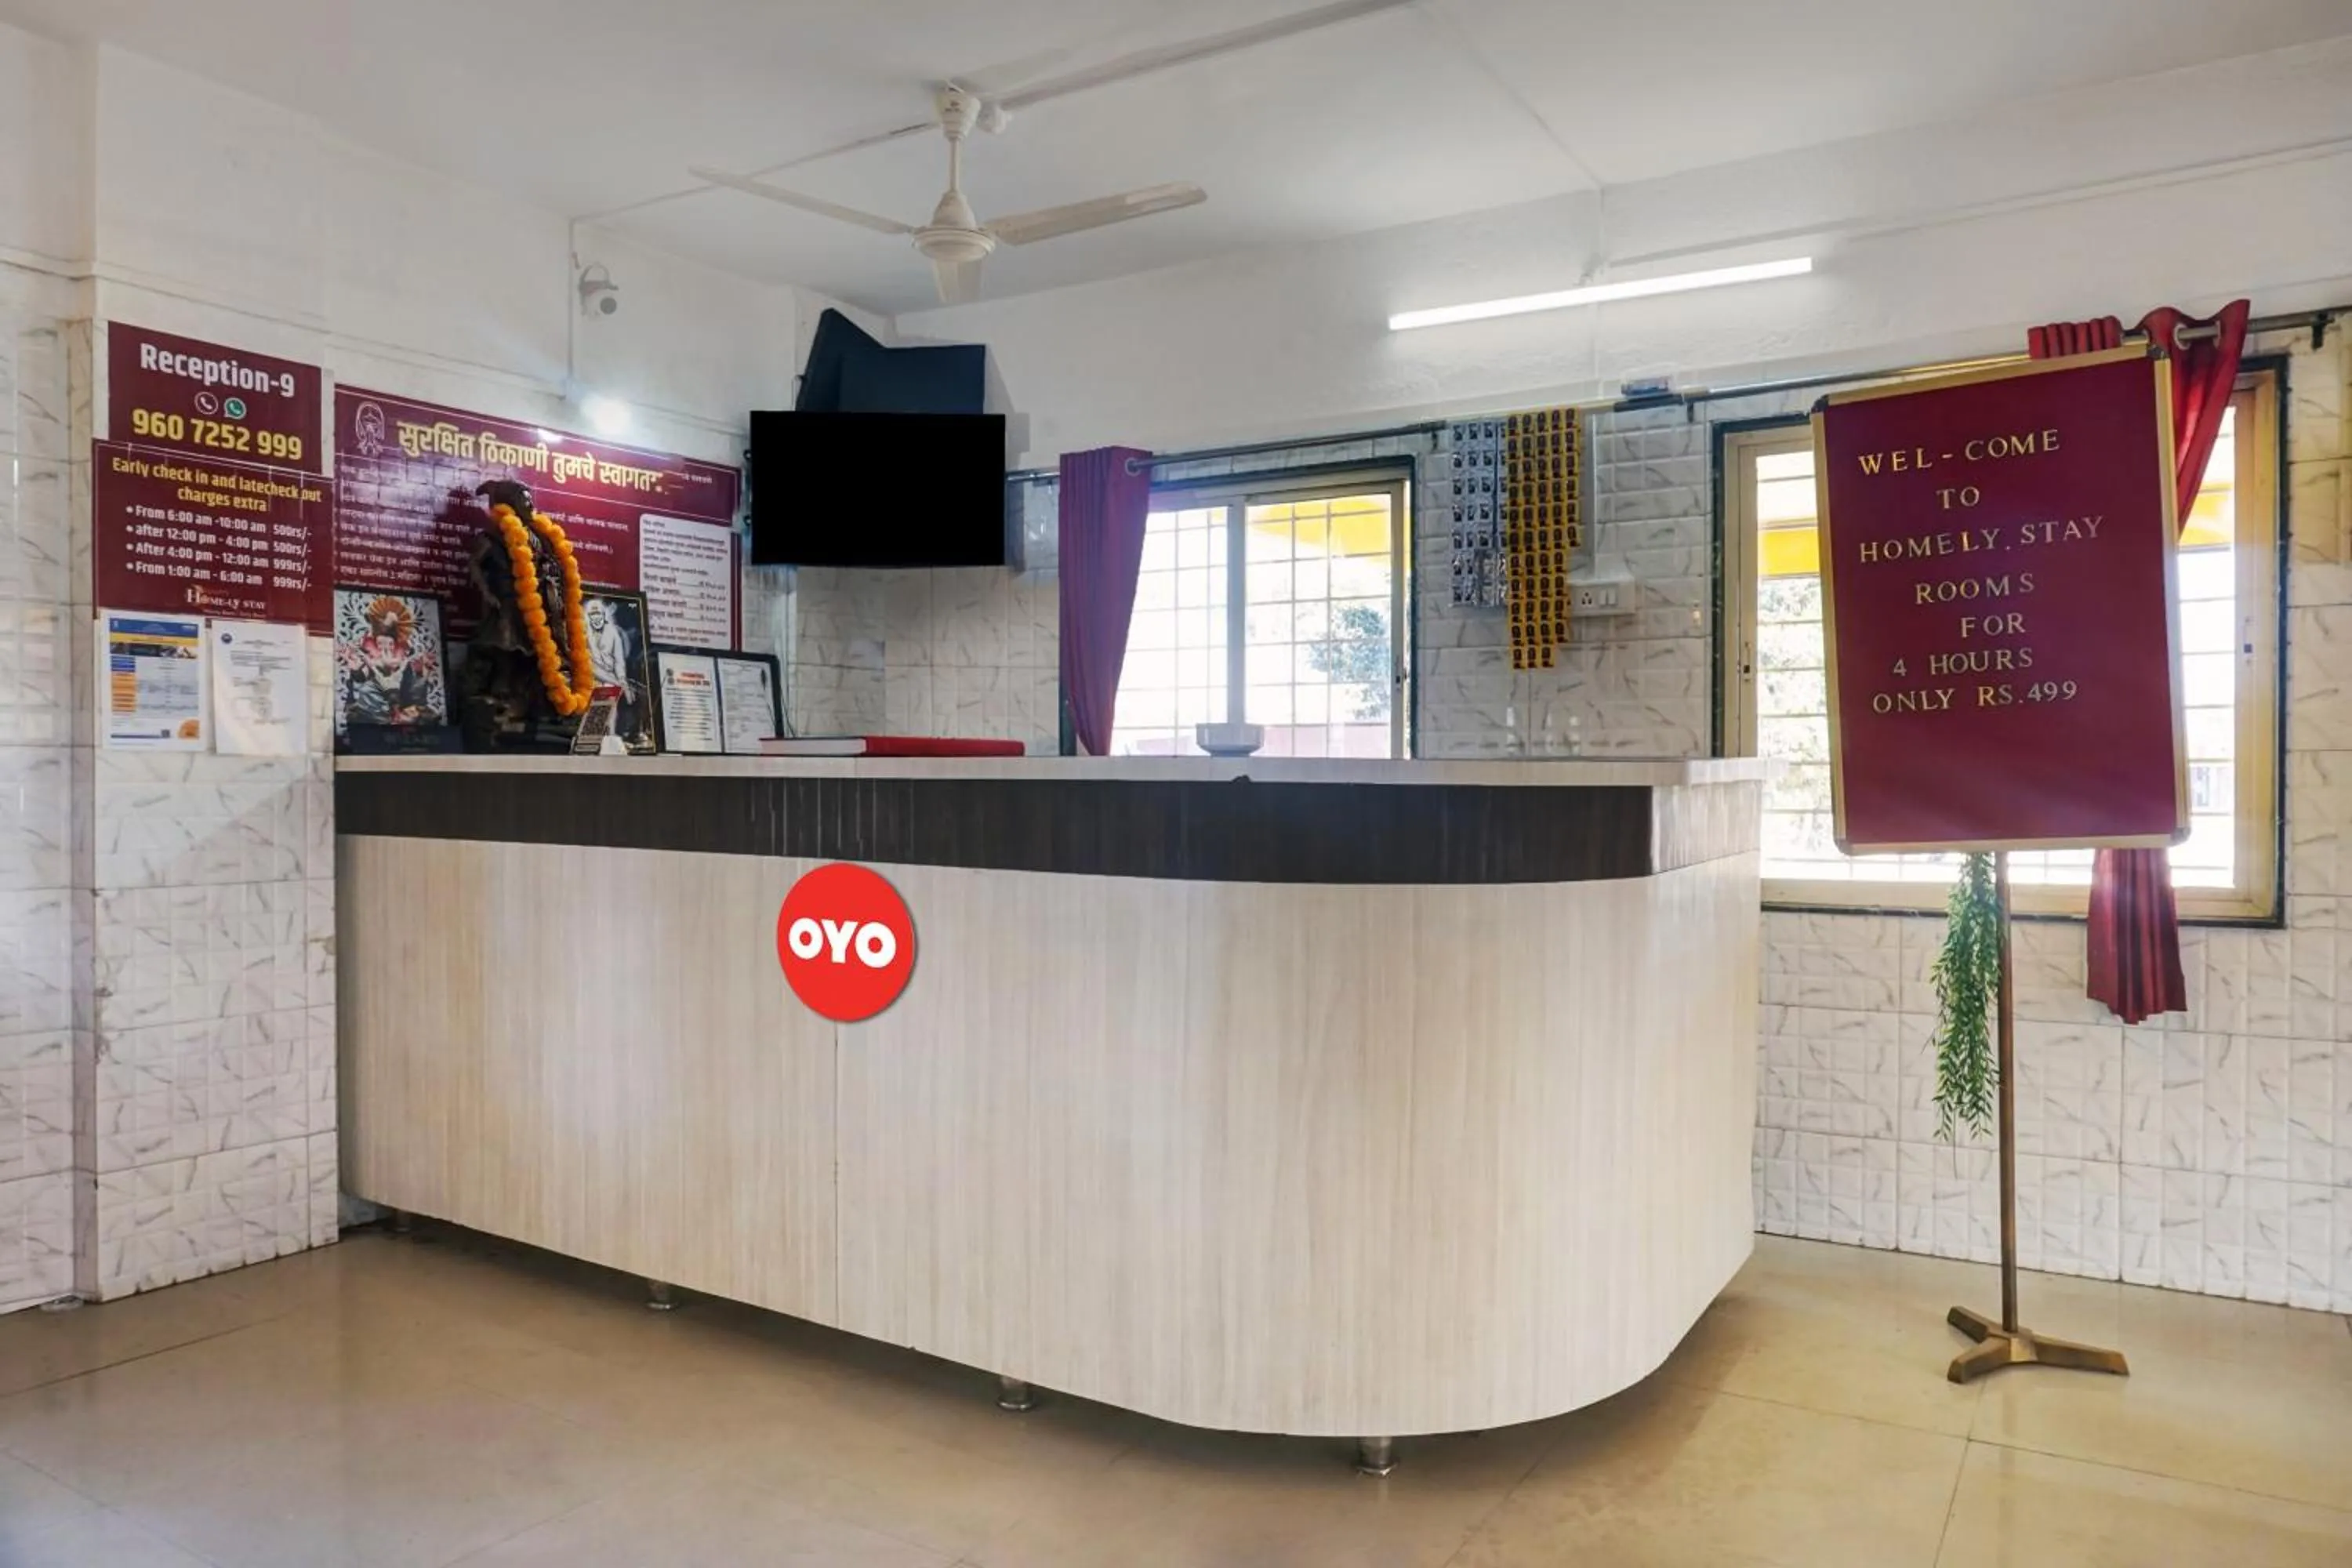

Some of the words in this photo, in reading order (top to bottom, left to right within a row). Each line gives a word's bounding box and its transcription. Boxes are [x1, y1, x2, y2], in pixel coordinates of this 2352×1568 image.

[140, 343, 295, 398] Reception-9
[132, 408, 184, 441] 960
[191, 419, 250, 452] 7252
[257, 434, 303, 460] 999
[397, 421, 474, 458] सुरक्षित
[478, 432, 550, 473] ठिकाणी
[552, 452, 596, 484] तुमचे
[112, 457, 149, 478] Early
[153, 463, 193, 482] check
[196, 469, 209, 484] in
[212, 472, 236, 490] and
[239, 476, 298, 499] latecheck
[301, 489, 322, 503] out
[177, 486, 230, 507] charges
[234, 497, 268, 512] extra
[1936, 486, 1980, 510] TO
[135, 505, 165, 520] From
[195, 514, 212, 526] am
[250, 521, 266, 533] am
[166, 528, 197, 542] 12:00
[198, 532, 216, 546] pm
[225, 535, 250, 549] 4:00
[252, 539, 269, 553] pm
[135, 543, 165, 557] After
[167, 546, 193, 559] 4:00
[195, 550, 212, 563] pm
[223, 553, 250, 566] 12:00
[252, 557, 269, 568] am
[135, 561, 165, 575] From
[167, 564, 191, 578] 1:00
[193, 569, 211, 580] am
[246, 575, 263, 586] am
[1915, 573, 2036, 605] ROOMS
[1960, 612, 2026, 638] FOR
[1893, 659, 1907, 677] 4
[1929, 647, 2034, 677] HOURS
[1872, 688, 1955, 714] ONLY
[789, 917, 897, 969] OYO
